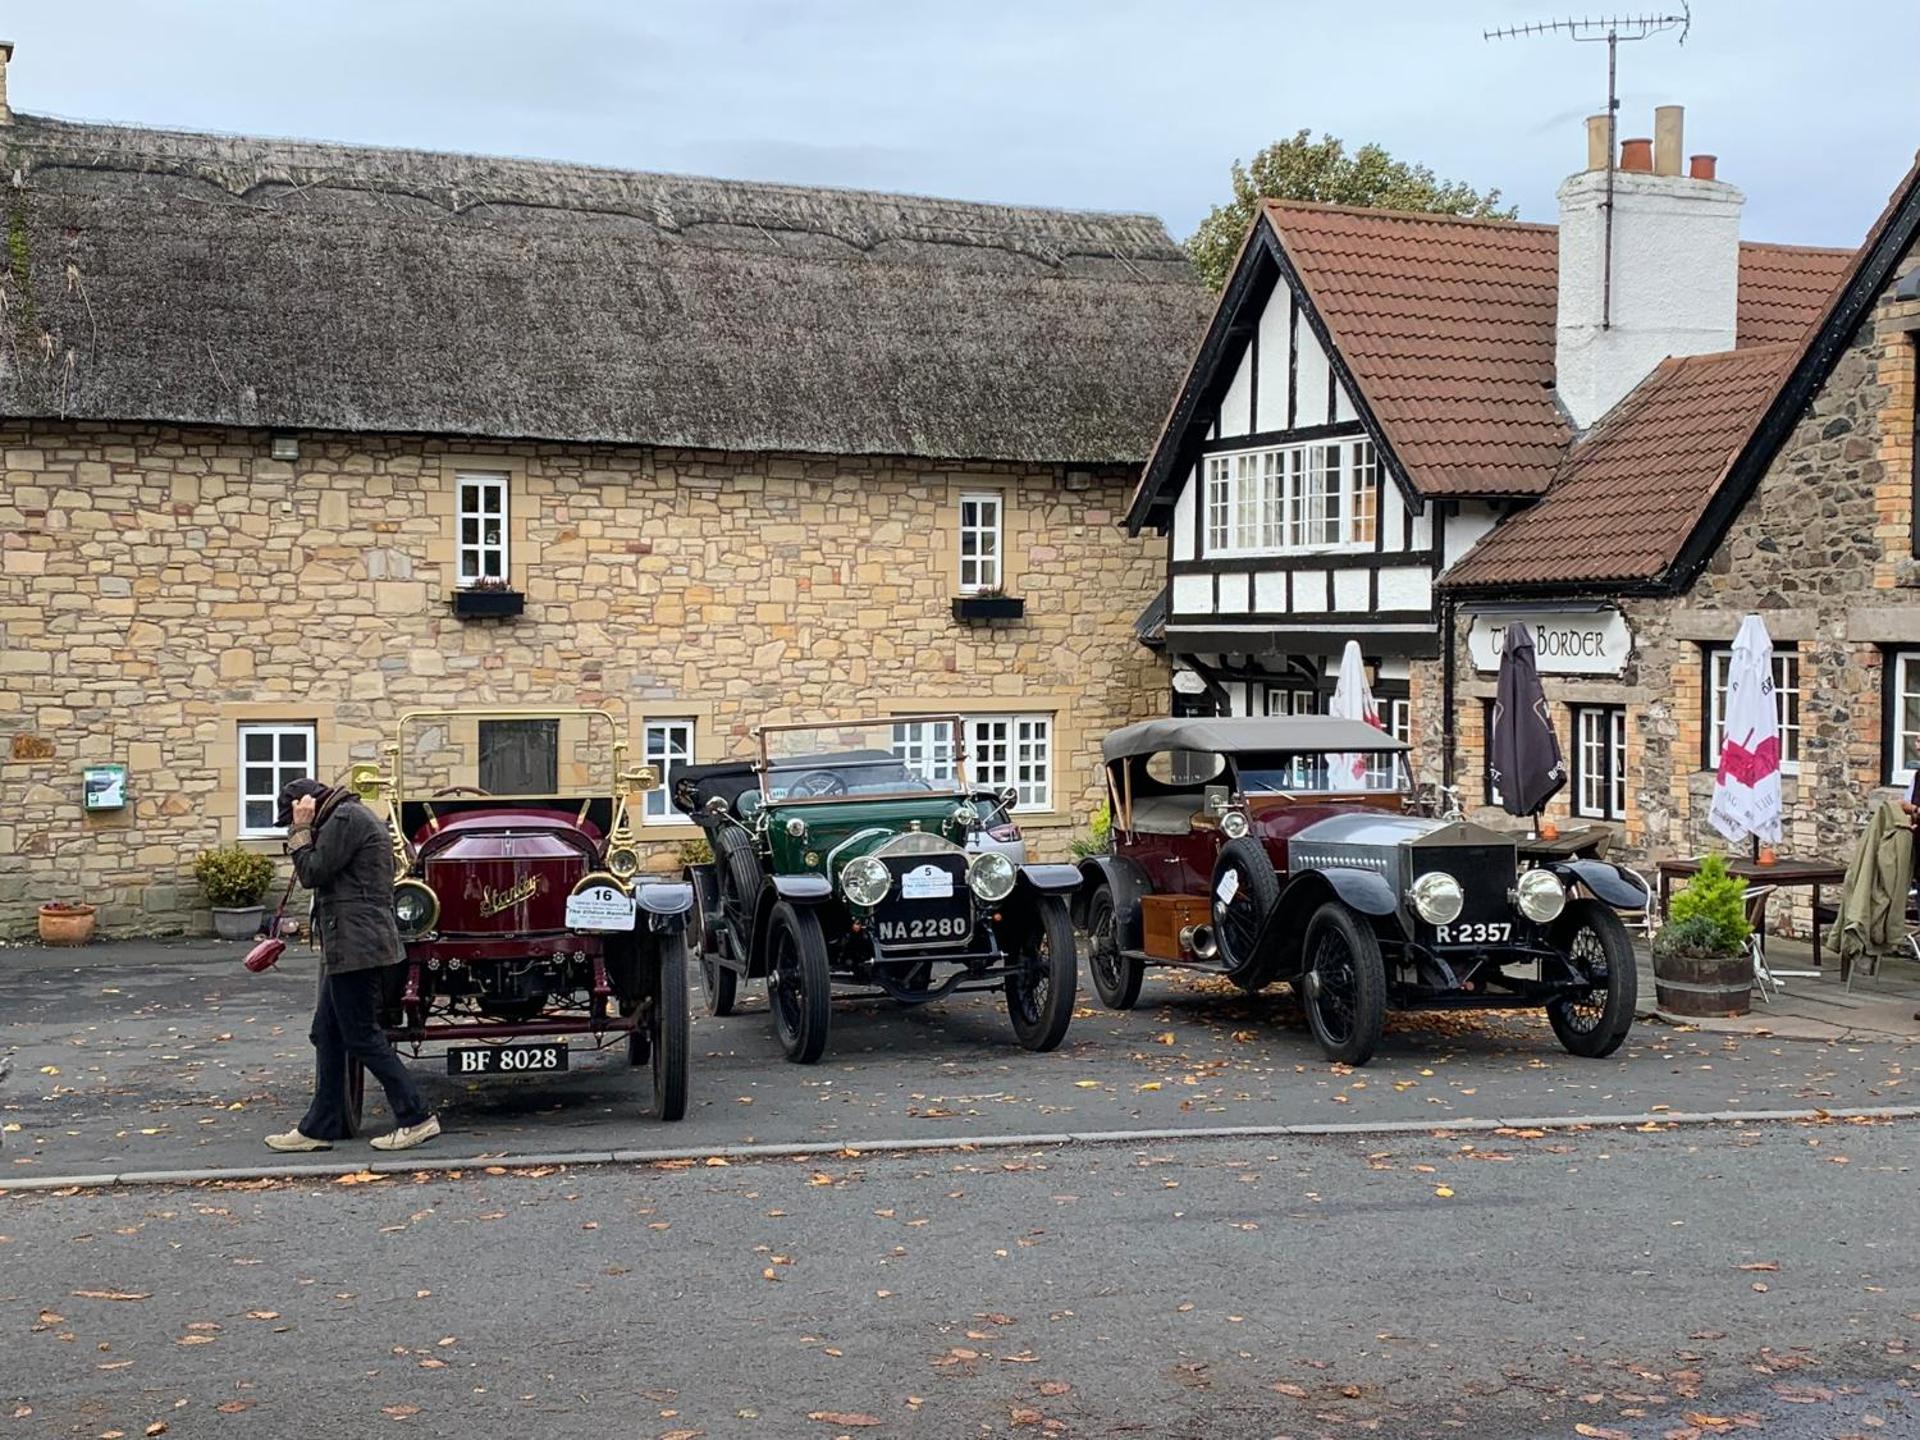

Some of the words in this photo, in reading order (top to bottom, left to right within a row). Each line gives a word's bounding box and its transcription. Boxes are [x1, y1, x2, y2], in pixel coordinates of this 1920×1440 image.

[925, 868, 932, 876] 5
[594, 889, 612, 901] 16
[879, 918, 966, 939] NA2280
[461, 1051, 491, 1072] BF
[500, 1049, 557, 1070] 8028
